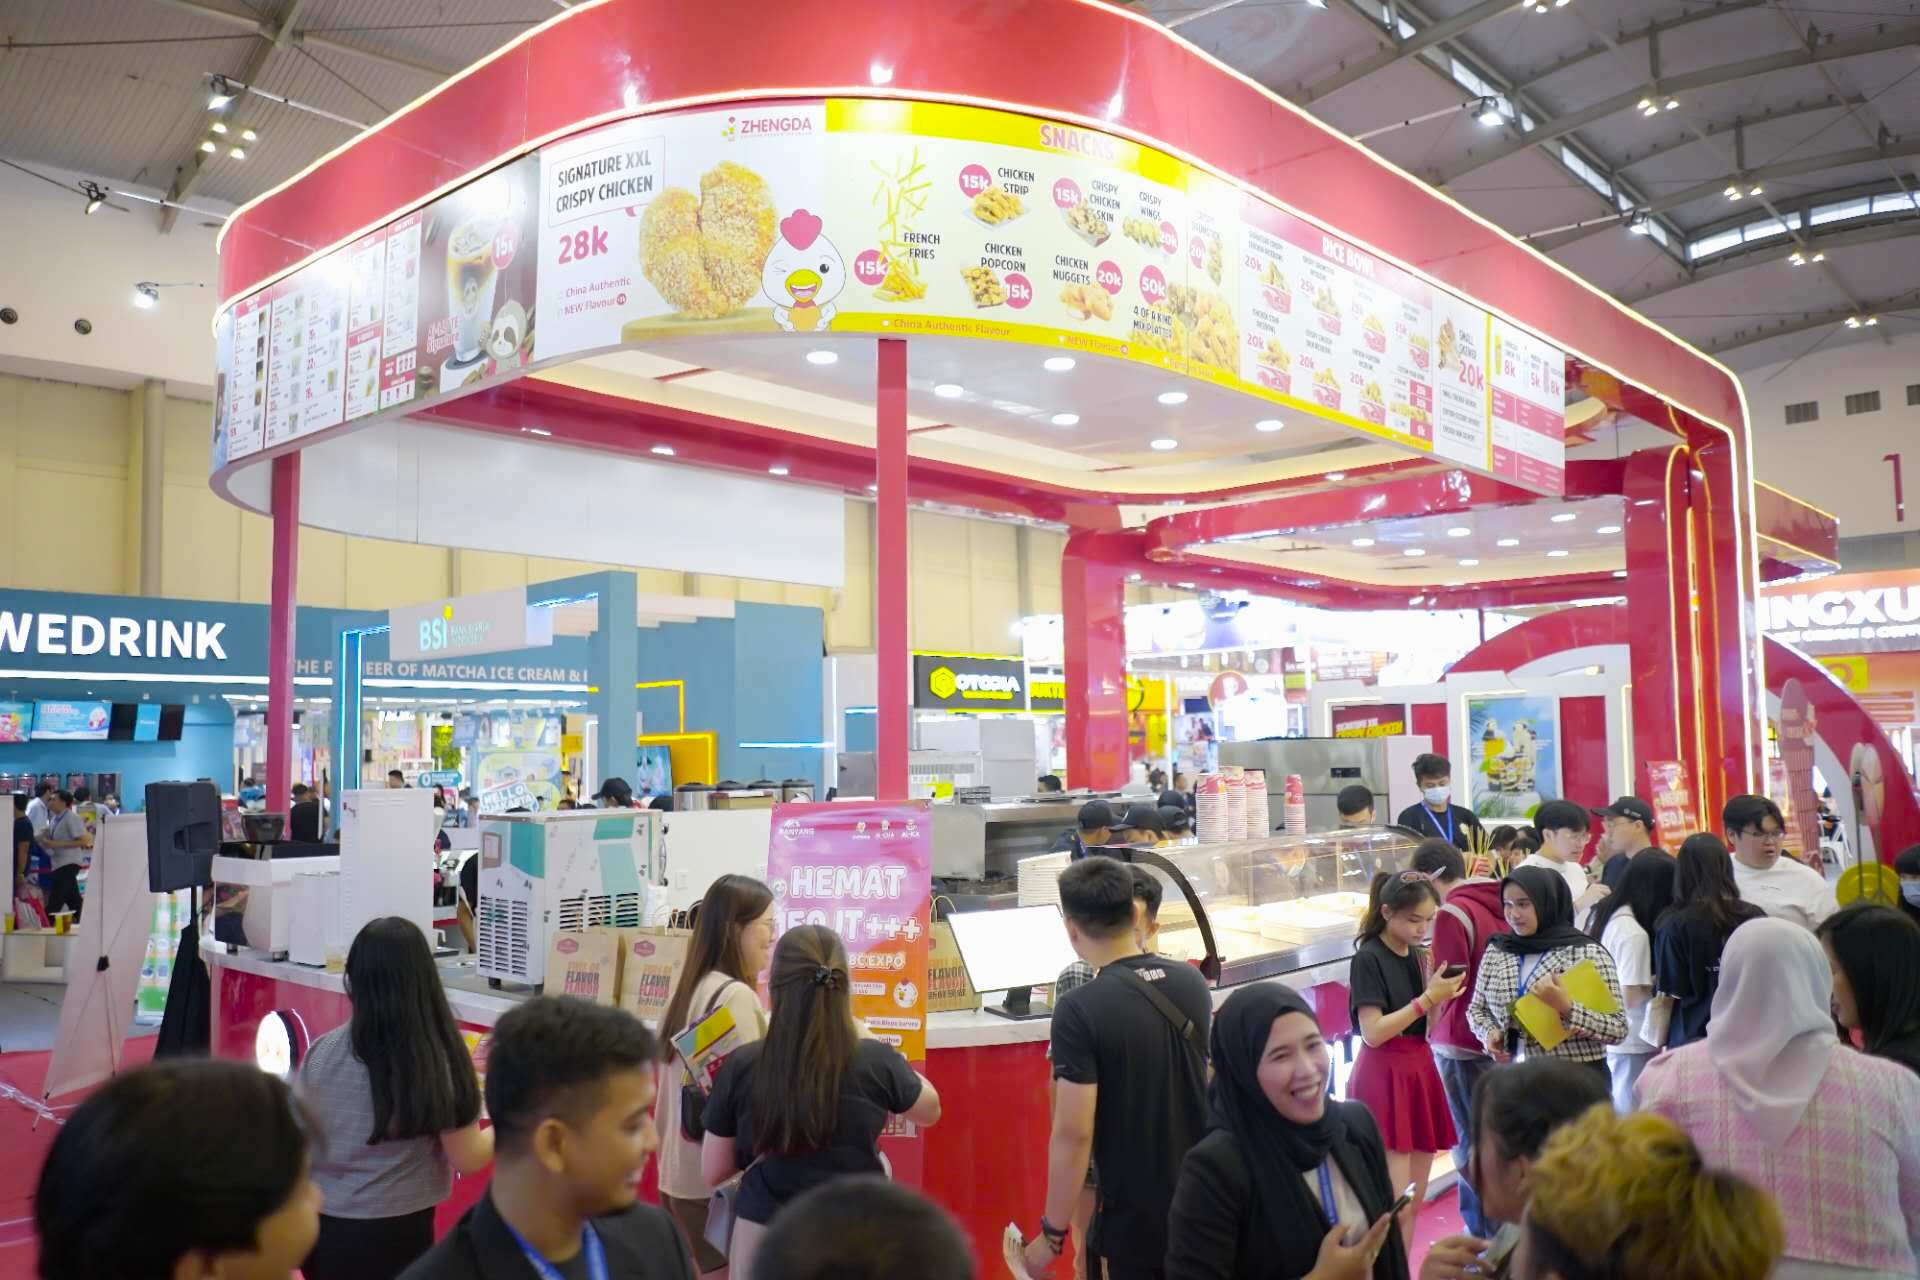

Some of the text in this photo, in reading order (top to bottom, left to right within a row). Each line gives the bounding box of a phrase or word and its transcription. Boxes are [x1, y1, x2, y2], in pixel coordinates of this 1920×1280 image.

[741, 117, 812, 133] ZHENGDA
[1040, 124, 1114, 160] SNACKS
[558, 150, 652, 187] SIGNATURE XXL
[998, 167, 1034, 182] CHICKEN
[556, 175, 653, 213] CRISPY CHICKEN
[1004, 183, 1029, 195] STRIP
[1091, 180, 1118, 194] CRISPY
[1090, 194, 1120, 209] CHICKEN
[1139, 191, 1162, 206] CRISPY
[1096, 210, 1114, 222] SKIN
[1140, 207, 1162, 221] WINGS
[558, 225, 609, 264] 28k
[904, 232, 940, 244] FRENCH
[909, 248, 935, 259] FRIES
[984, 242, 1023, 256] CHICKEN
[857, 261, 886, 275] 15k
[981, 257, 1026, 272] POPCORN
[1056, 254, 1088, 270] CHICKEN
[1053, 270, 1090, 285] NUGGETS
[1098, 269, 1121, 285] 20k
[566, 276, 632, 298] China Authentic
[1142, 279, 1166, 297] 50k
[564, 302, 584, 315] NEW
[894, 318, 1010, 336] China Authentic Flavour
[1248, 334, 1264, 350] 20k
[1459, 360, 1484, 390] 20k
[0, 611, 228, 660] WEDRINK
[420, 617, 448, 652] BSI
[398, 662, 417, 677] OF
[422, 663, 487, 680] MATCHA
[489, 665, 514, 681] ICE
[518, 667, 566, 682] CREAM
[792, 867, 906, 898] HEMAT
[868, 952, 905, 969] EXPO
[566, 970, 600, 984] FLAVOR
